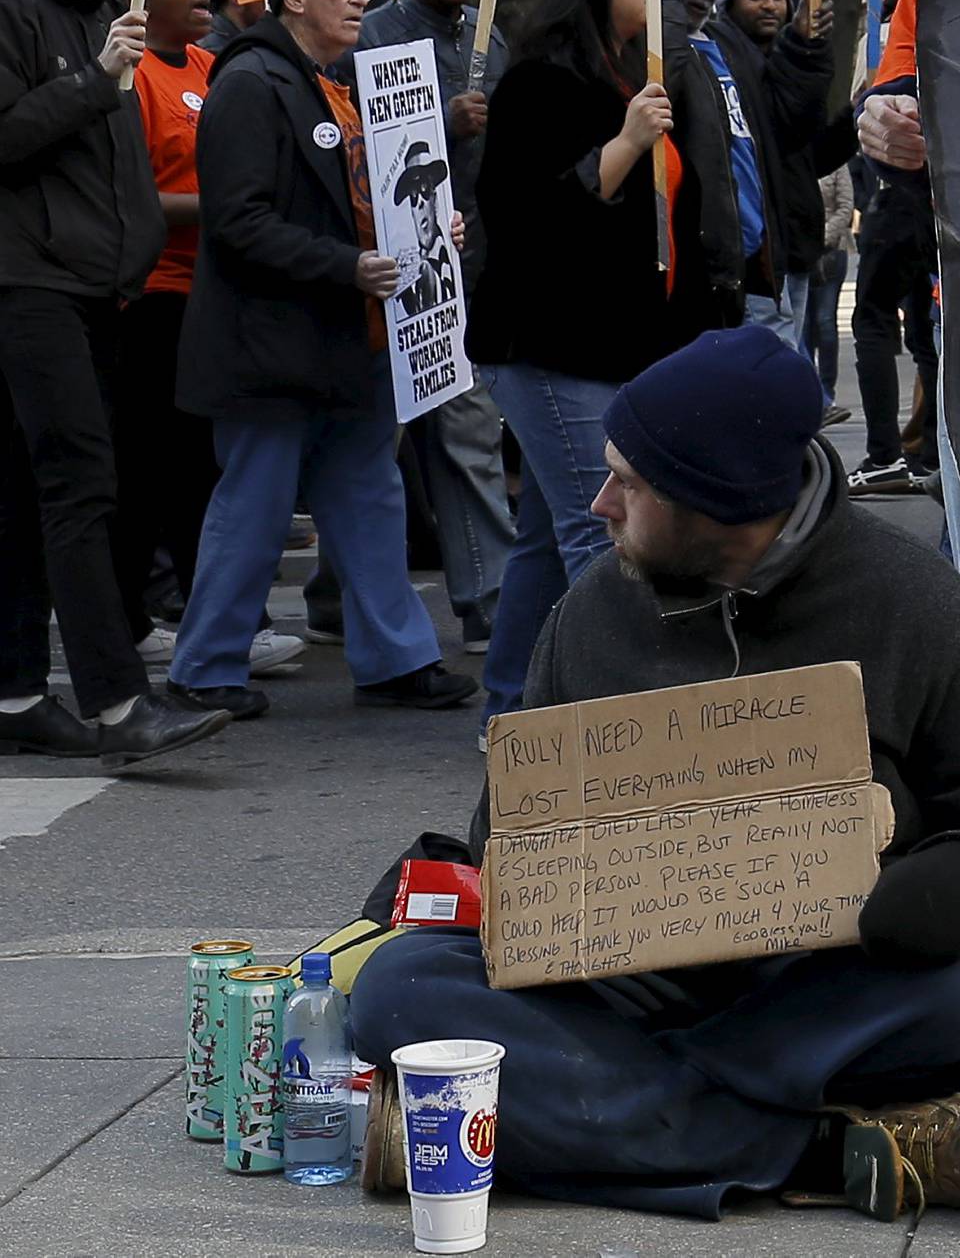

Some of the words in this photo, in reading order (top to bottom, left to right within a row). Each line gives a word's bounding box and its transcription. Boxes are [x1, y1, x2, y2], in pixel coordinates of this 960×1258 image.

[371, 56, 422, 91] WANTED:
[367, 94, 395, 125] KEN
[393, 84, 436, 119] GRIFFIN
[397, 317, 434, 352] STEALS
[433, 304, 459, 336] FROM
[408, 335, 453, 376] WORKING
[413, 360, 457, 404] FAMILIES
[492, 728, 563, 773] TRULY
[585, 718, 644, 756] NEED
[668, 709, 683, 741] A
[701, 695, 812, 732] MIRACLE.
[495, 783, 568, 818] LOST
[584, 753, 705, 804] EVERYTHING
[717, 750, 775, 778] WHEN
[788, 744, 817, 771] MY
[500, 826, 580, 857] DAUGHTER
[646, 810, 695, 832] LAST
[710, 800, 763, 828] YEAR
[512, 853, 598, 881] SLEEPING
[608, 840, 693, 866] OUTSIDE,
[697, 835, 732, 854] BUT
[821, 817, 865, 836] NOT
[501, 889, 511, 911] A
[519, 880, 557, 910] BAD
[747, 854, 779, 875] IF
[791, 849, 828, 874] YOU
[501, 919, 543, 942] COULD
[551, 909, 586, 936] HELP
[593, 906, 619, 927] IT
[631, 893, 689, 917] WOULD
[699, 885, 726, 904] BE
[736, 880, 785, 901] SUCH
[797, 870, 811, 889] A
[570, 930, 622, 957] THANK
[661, 916, 707, 939] VERY
[715, 908, 761, 931] MUCH
[772, 900, 783, 921] 4
[793, 898, 833, 922] YOUR
[414, 1143, 448, 1157] JAM
[414, 1155, 447, 1166] FEST
